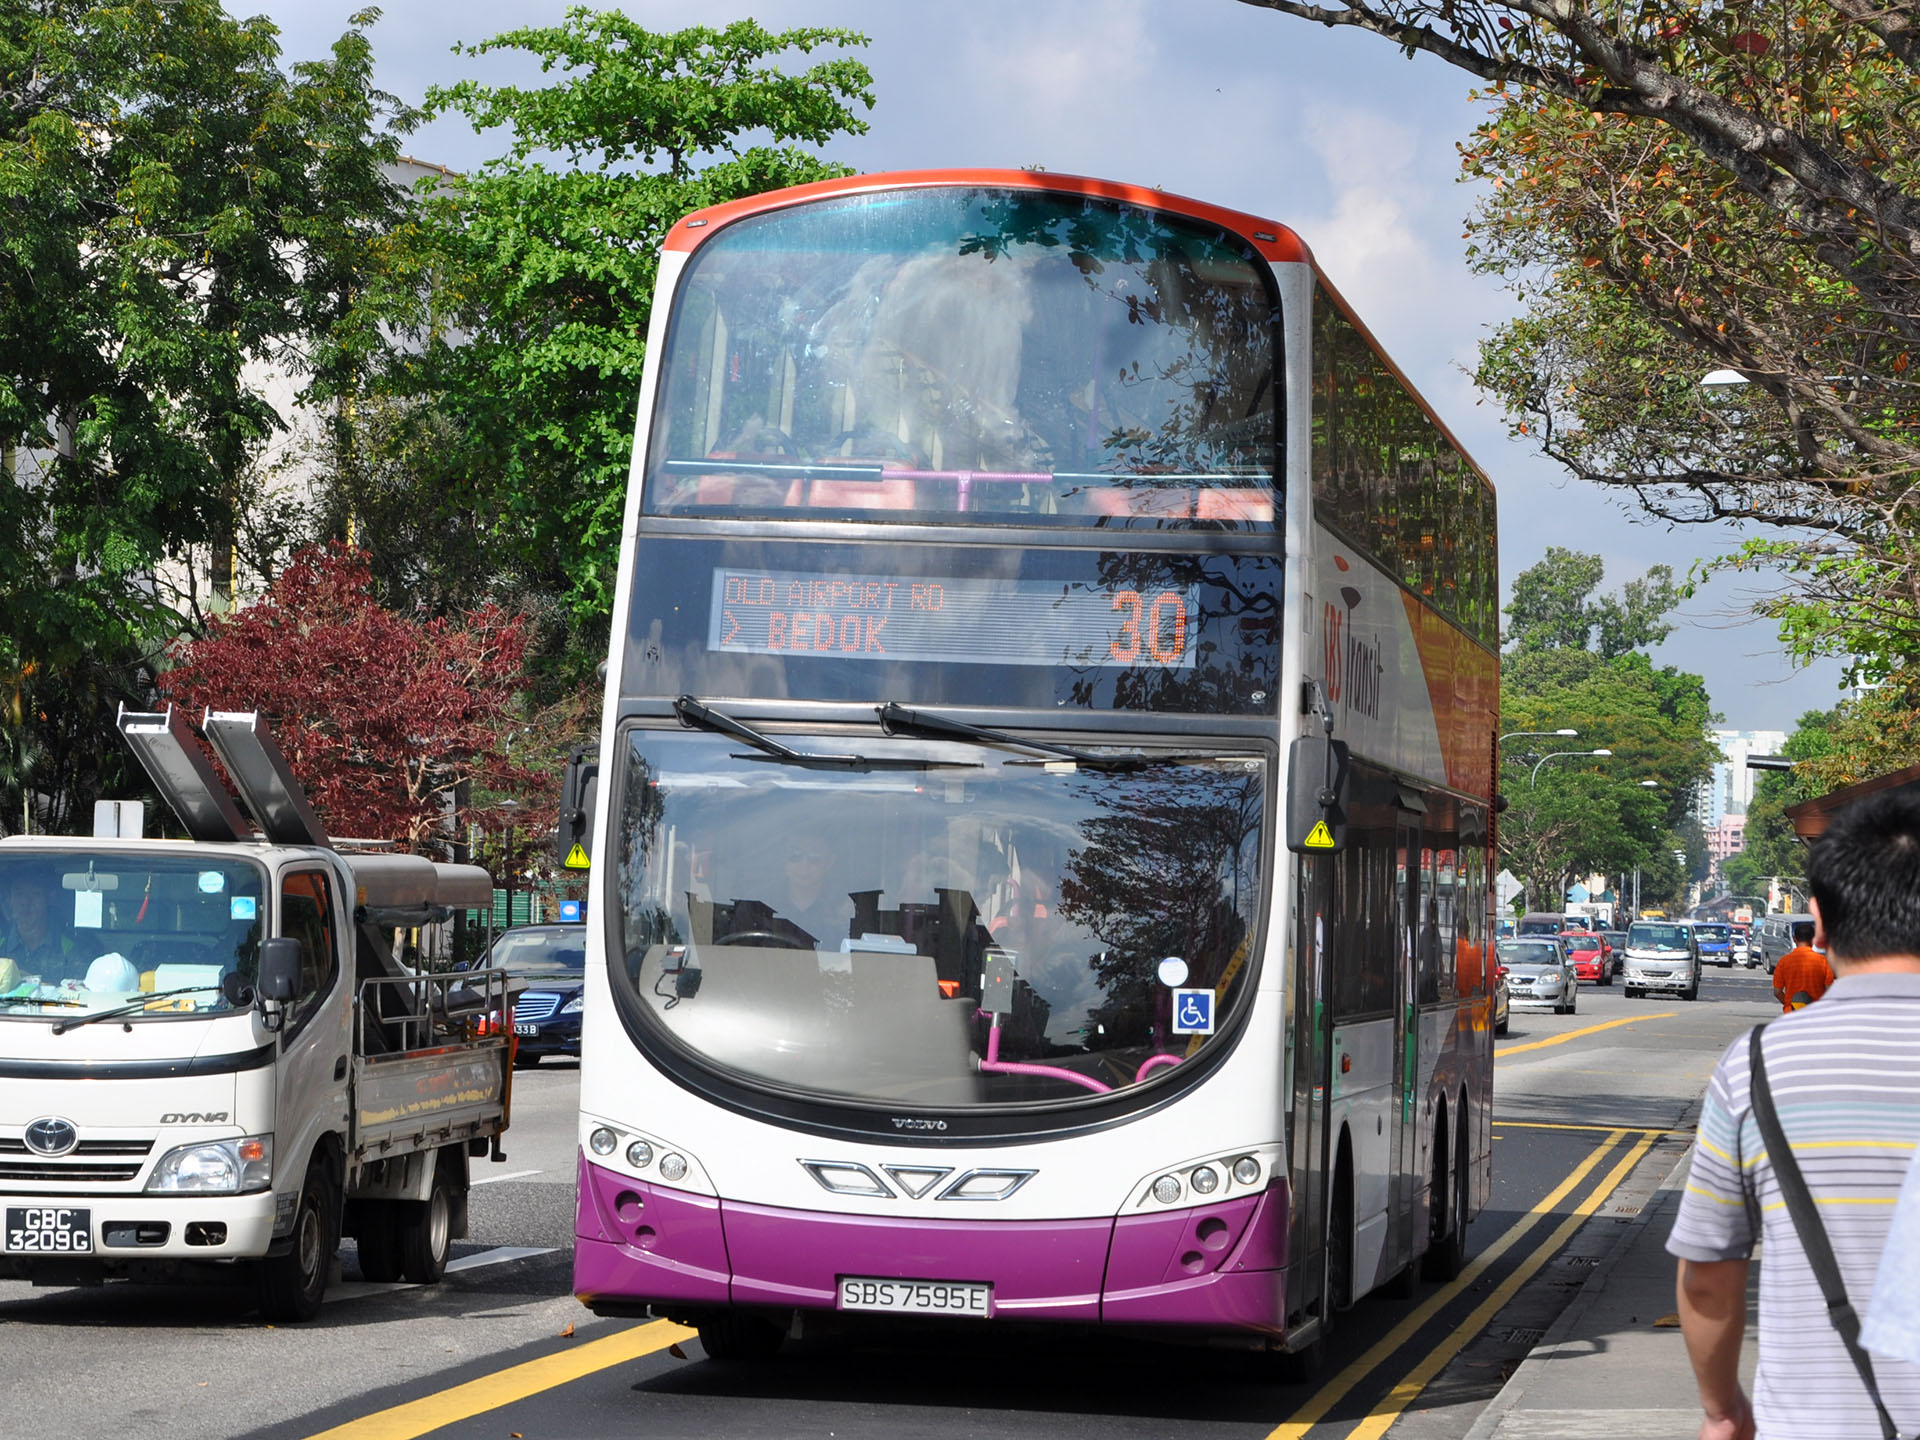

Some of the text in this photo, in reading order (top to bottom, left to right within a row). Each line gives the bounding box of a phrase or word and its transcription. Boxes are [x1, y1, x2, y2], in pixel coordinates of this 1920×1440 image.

[724, 577, 944, 611] OLD AIRPORT RD
[767, 611, 888, 653] BEDOK
[1109, 588, 1187, 664] 30
[1323, 586, 1384, 728] SBS Transit
[159, 1112, 229, 1124] DYNA
[891, 1117, 948, 1131] VOLVO
[25, 1208, 72, 1230] GBC
[8, 1229, 88, 1251] 3209G
